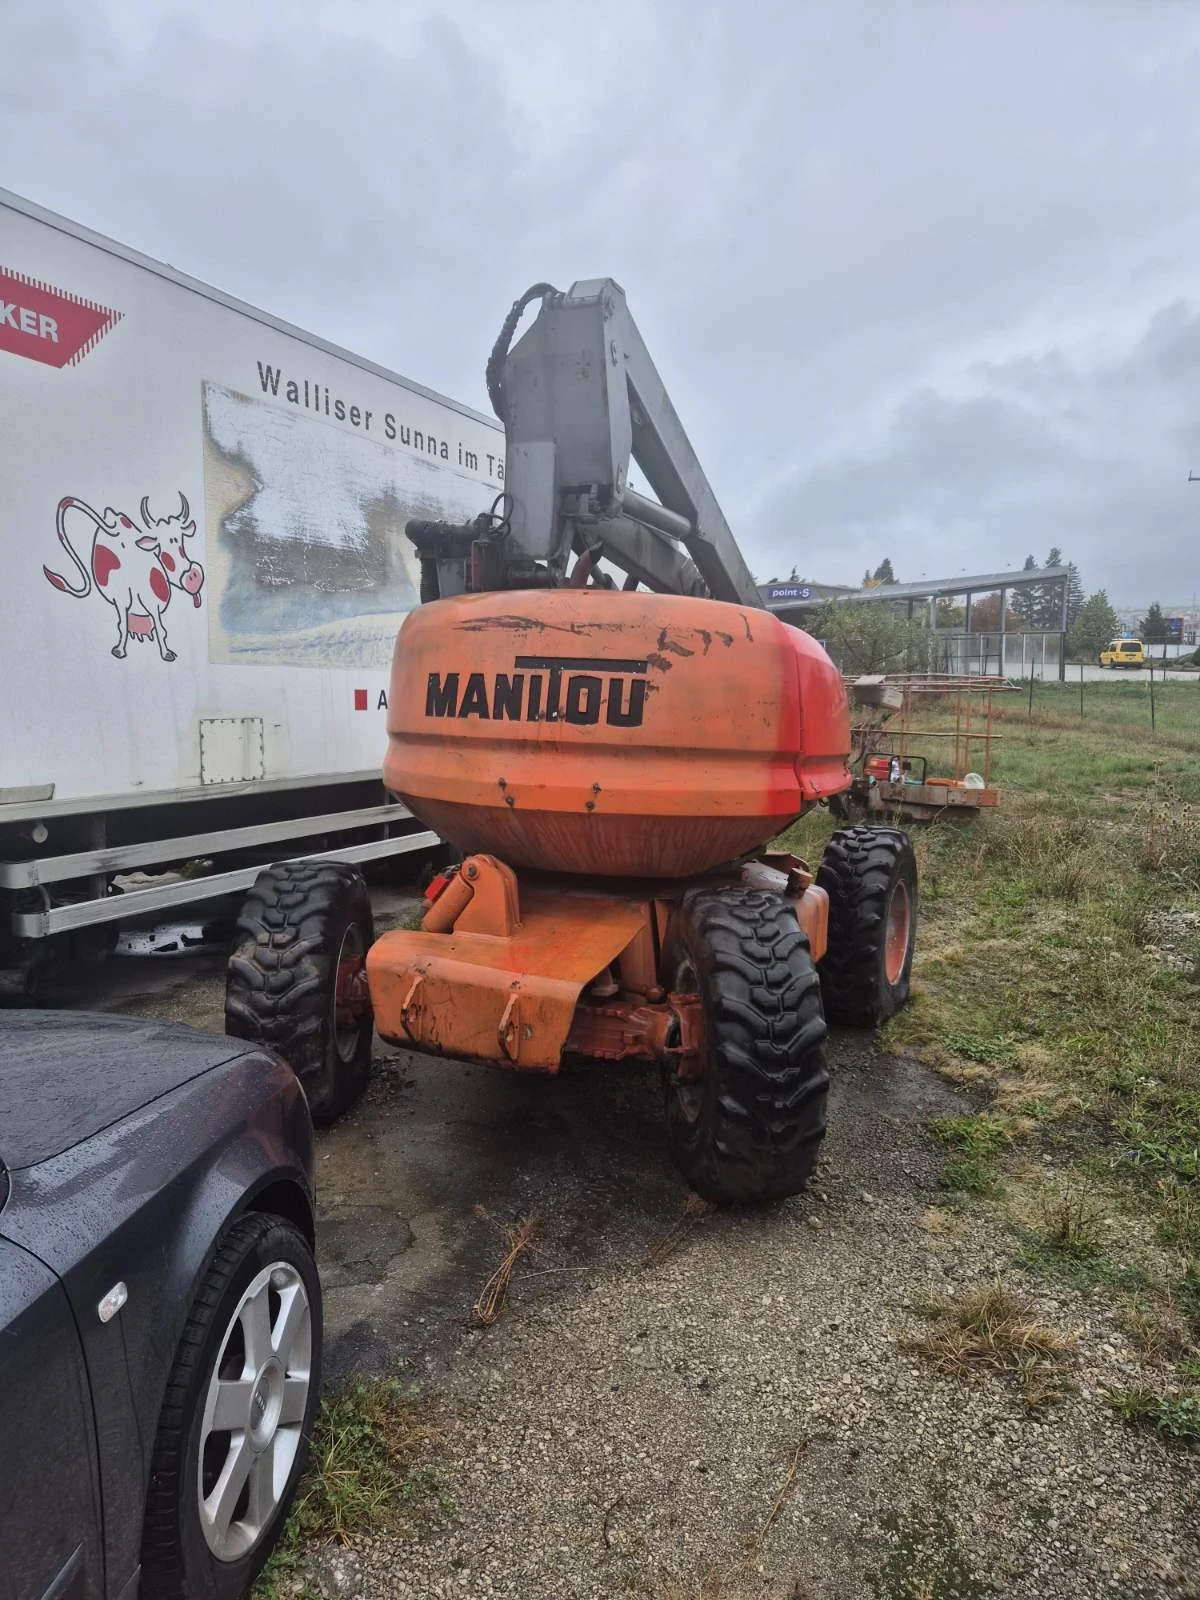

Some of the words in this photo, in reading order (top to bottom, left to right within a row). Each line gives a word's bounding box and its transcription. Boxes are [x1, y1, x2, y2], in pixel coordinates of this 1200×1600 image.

[0, 299, 58, 343] KER
[257, 360, 372, 430] Walliser
[384, 413, 448, 461] Sunna
[458, 441, 478, 471] im
[486, 454, 504, 481] Tä
[772, 588, 797, 597] point
[377, 689, 388, 710] A
[425, 655, 648, 728] MANITOU
